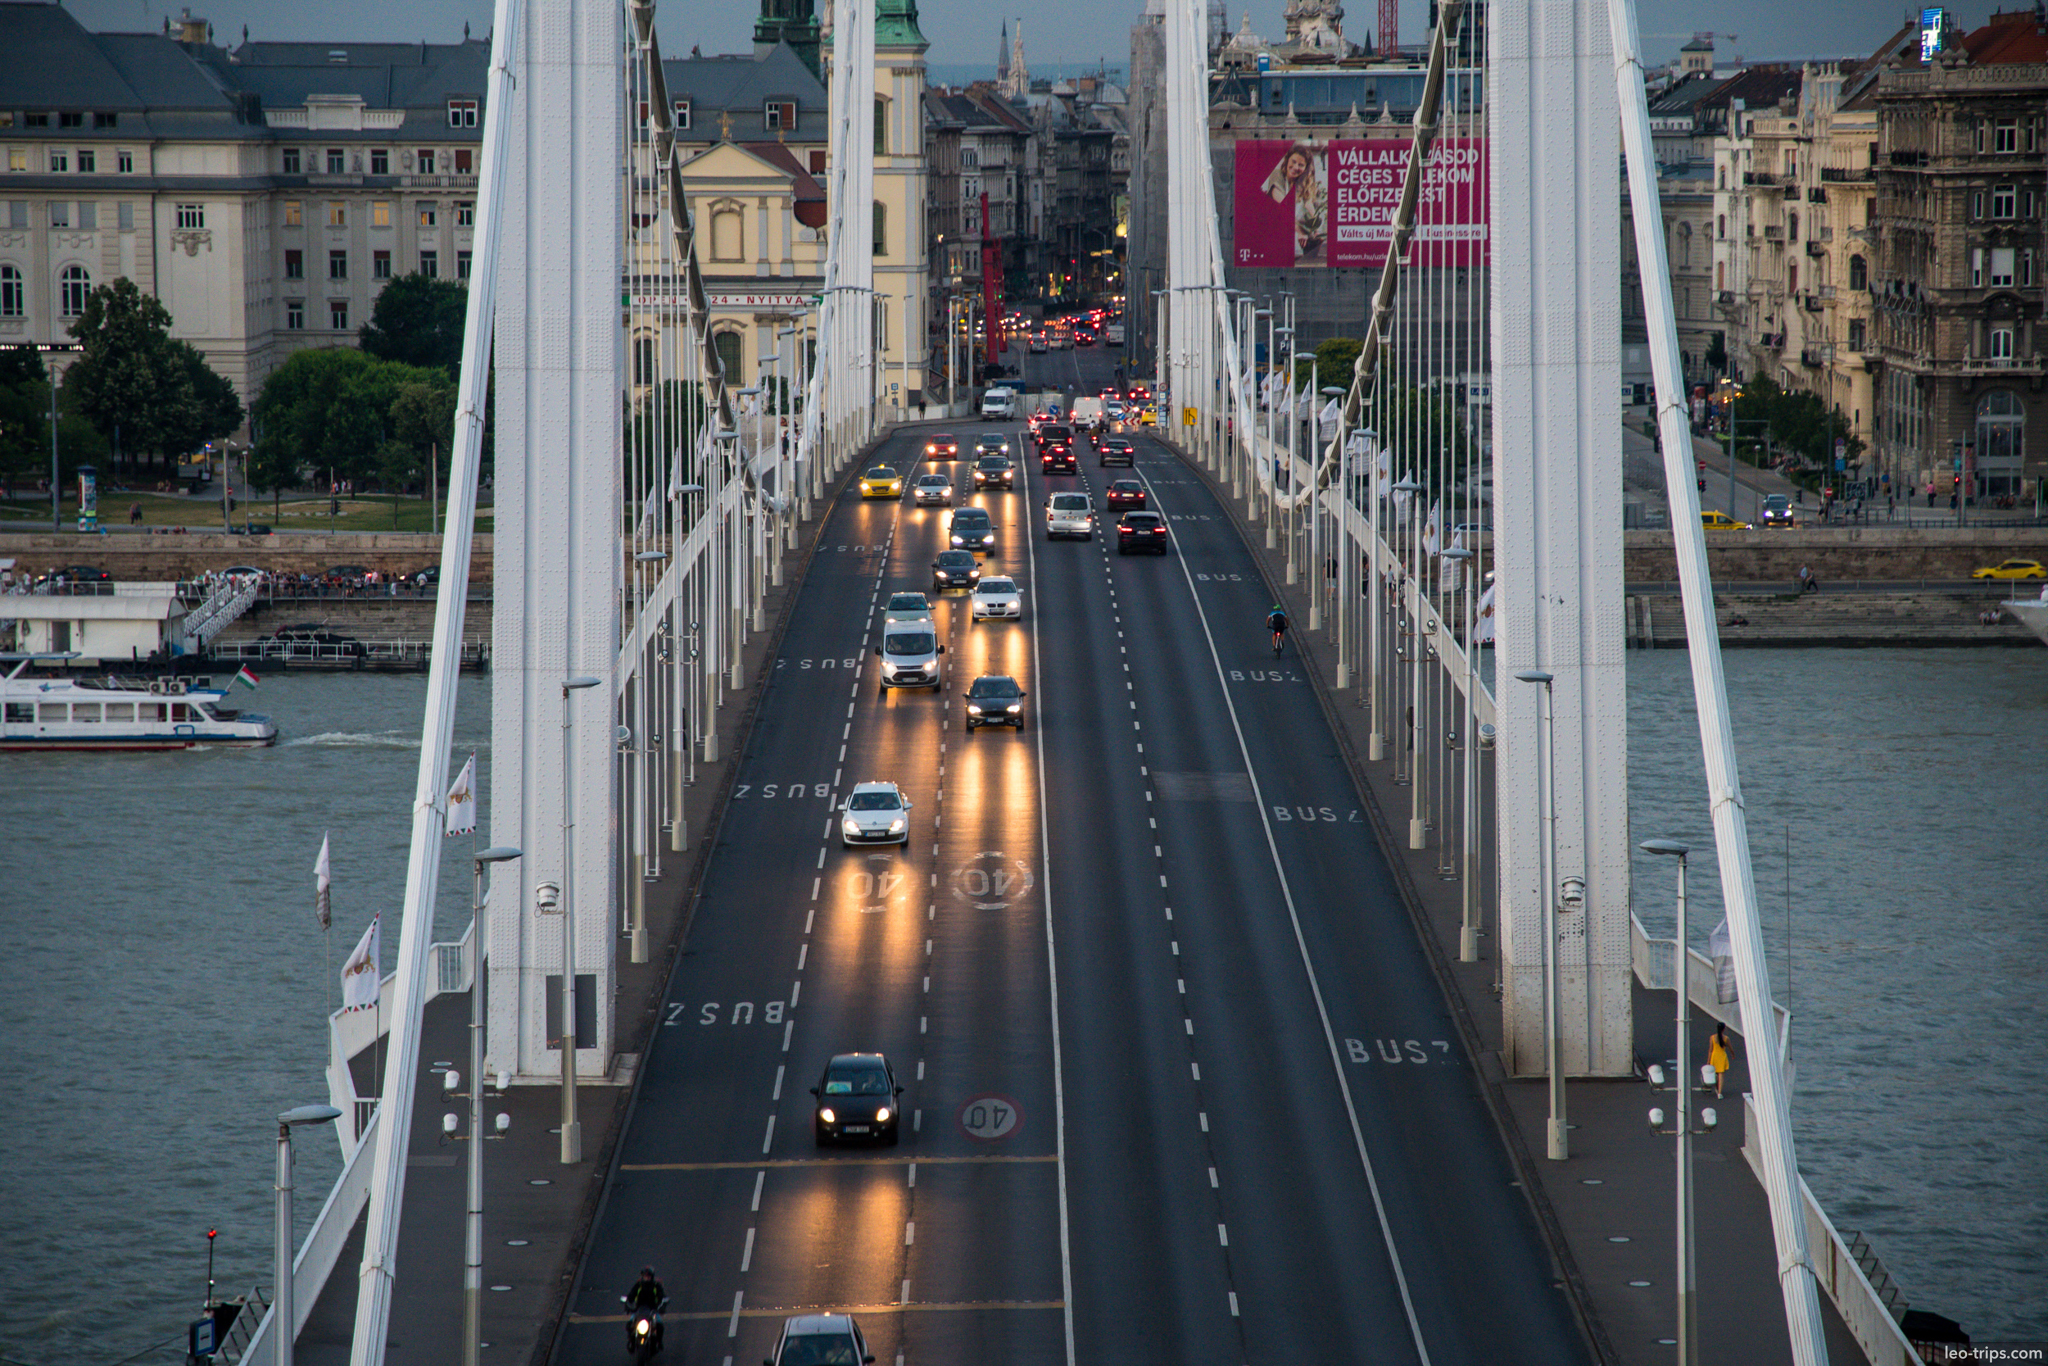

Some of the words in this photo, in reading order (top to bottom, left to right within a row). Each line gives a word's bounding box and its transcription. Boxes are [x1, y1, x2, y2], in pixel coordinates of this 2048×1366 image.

[1337, 147, 1479, 166] VÁLLALKÁSOD
[1337, 166, 1393, 184] CÉGES
[1341, 229, 1364, 239] Válts
[1366, 229, 1375, 241] új
[746, 295, 804, 305] NYITVA
[733, 783, 831, 799] BUSZ
[846, 871, 905, 900] 40
[964, 868, 1018, 897] 40
[664, 1001, 786, 1026] BUSZ
[970, 1105, 1009, 1130] 40
